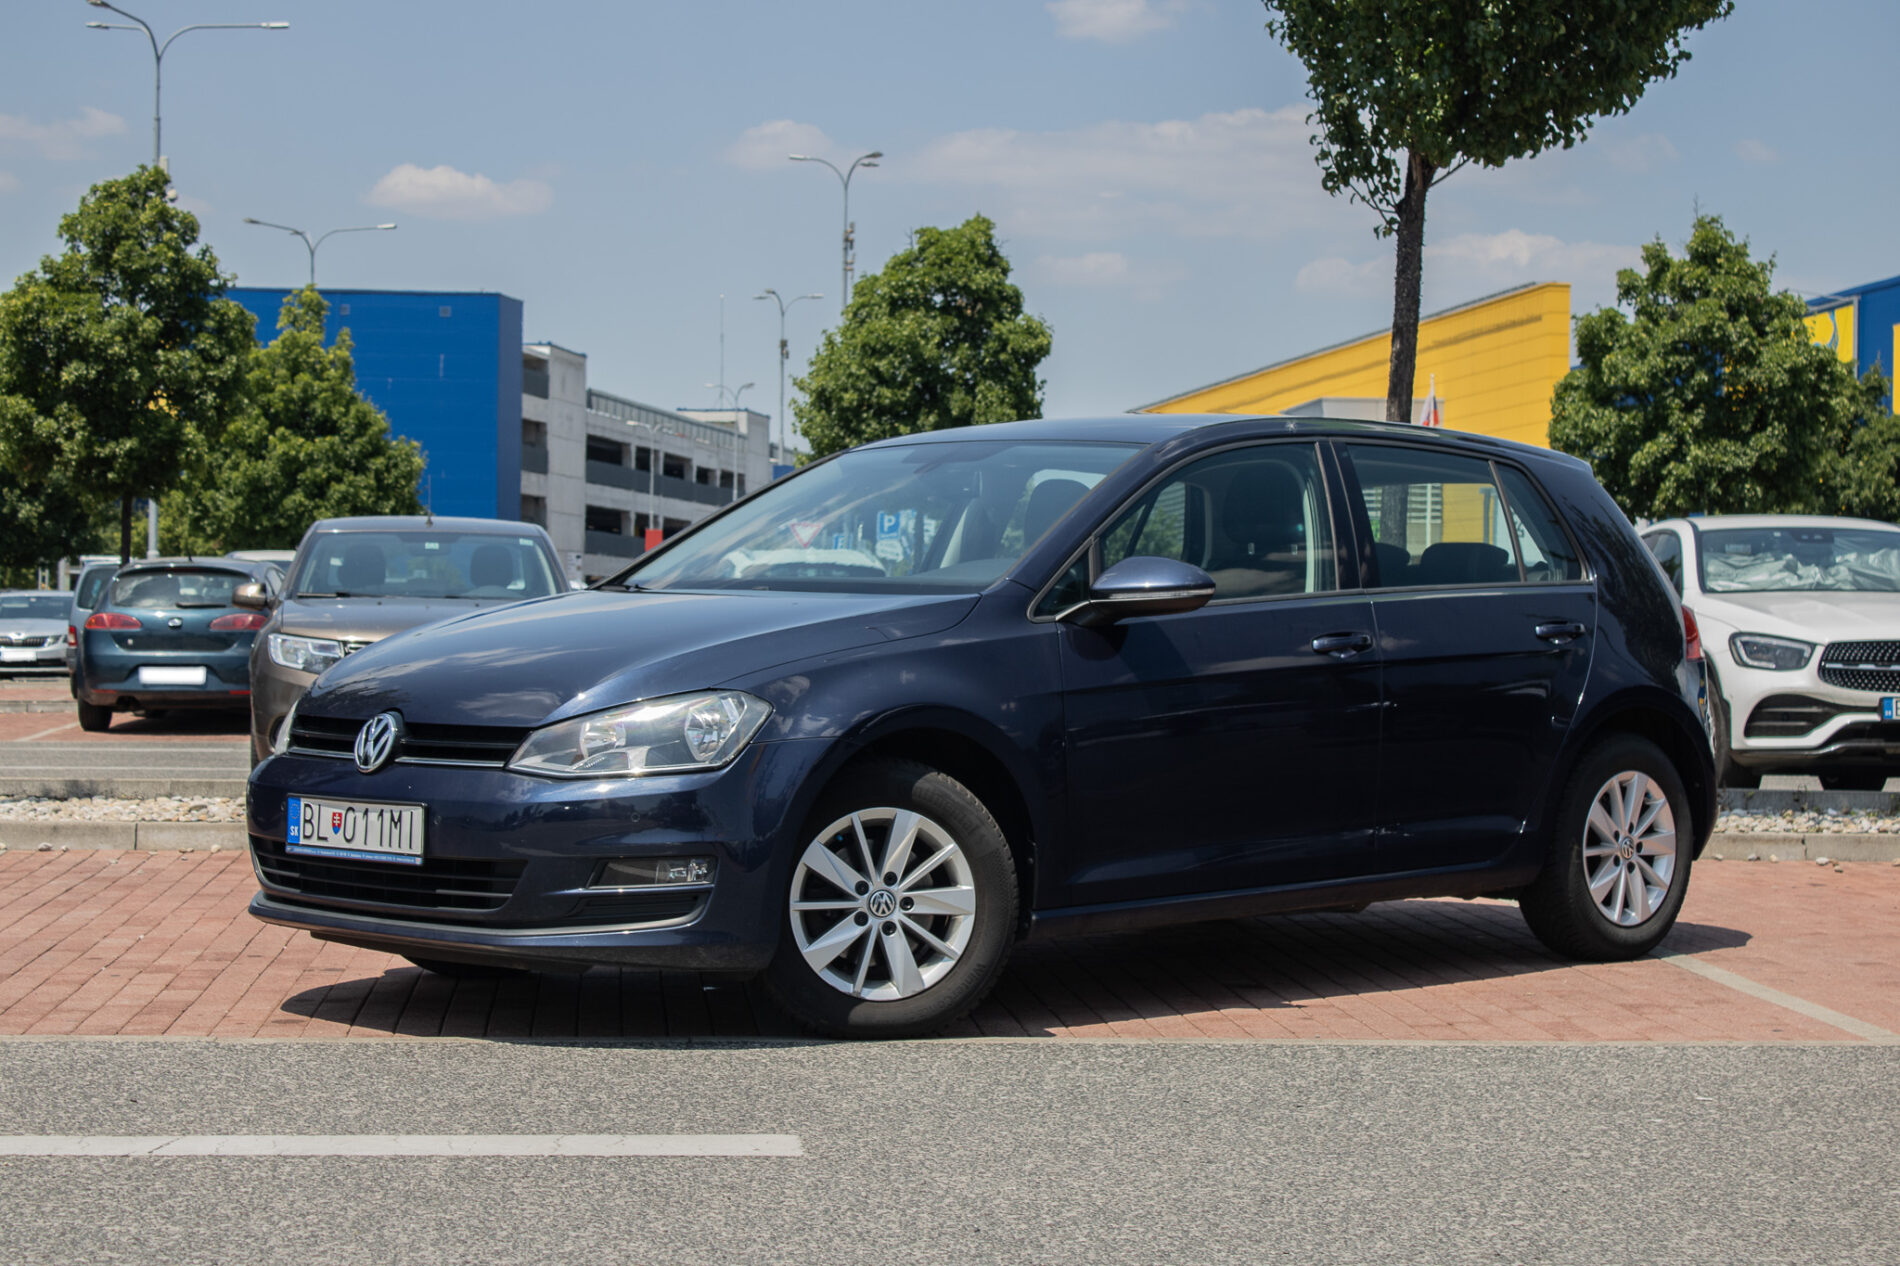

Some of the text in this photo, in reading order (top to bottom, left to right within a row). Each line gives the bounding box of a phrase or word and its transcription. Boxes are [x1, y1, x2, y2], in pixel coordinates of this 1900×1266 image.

[884, 514, 896, 532] P
[290, 825, 299, 836] SK
[303, 803, 414, 850] BL 011MI
